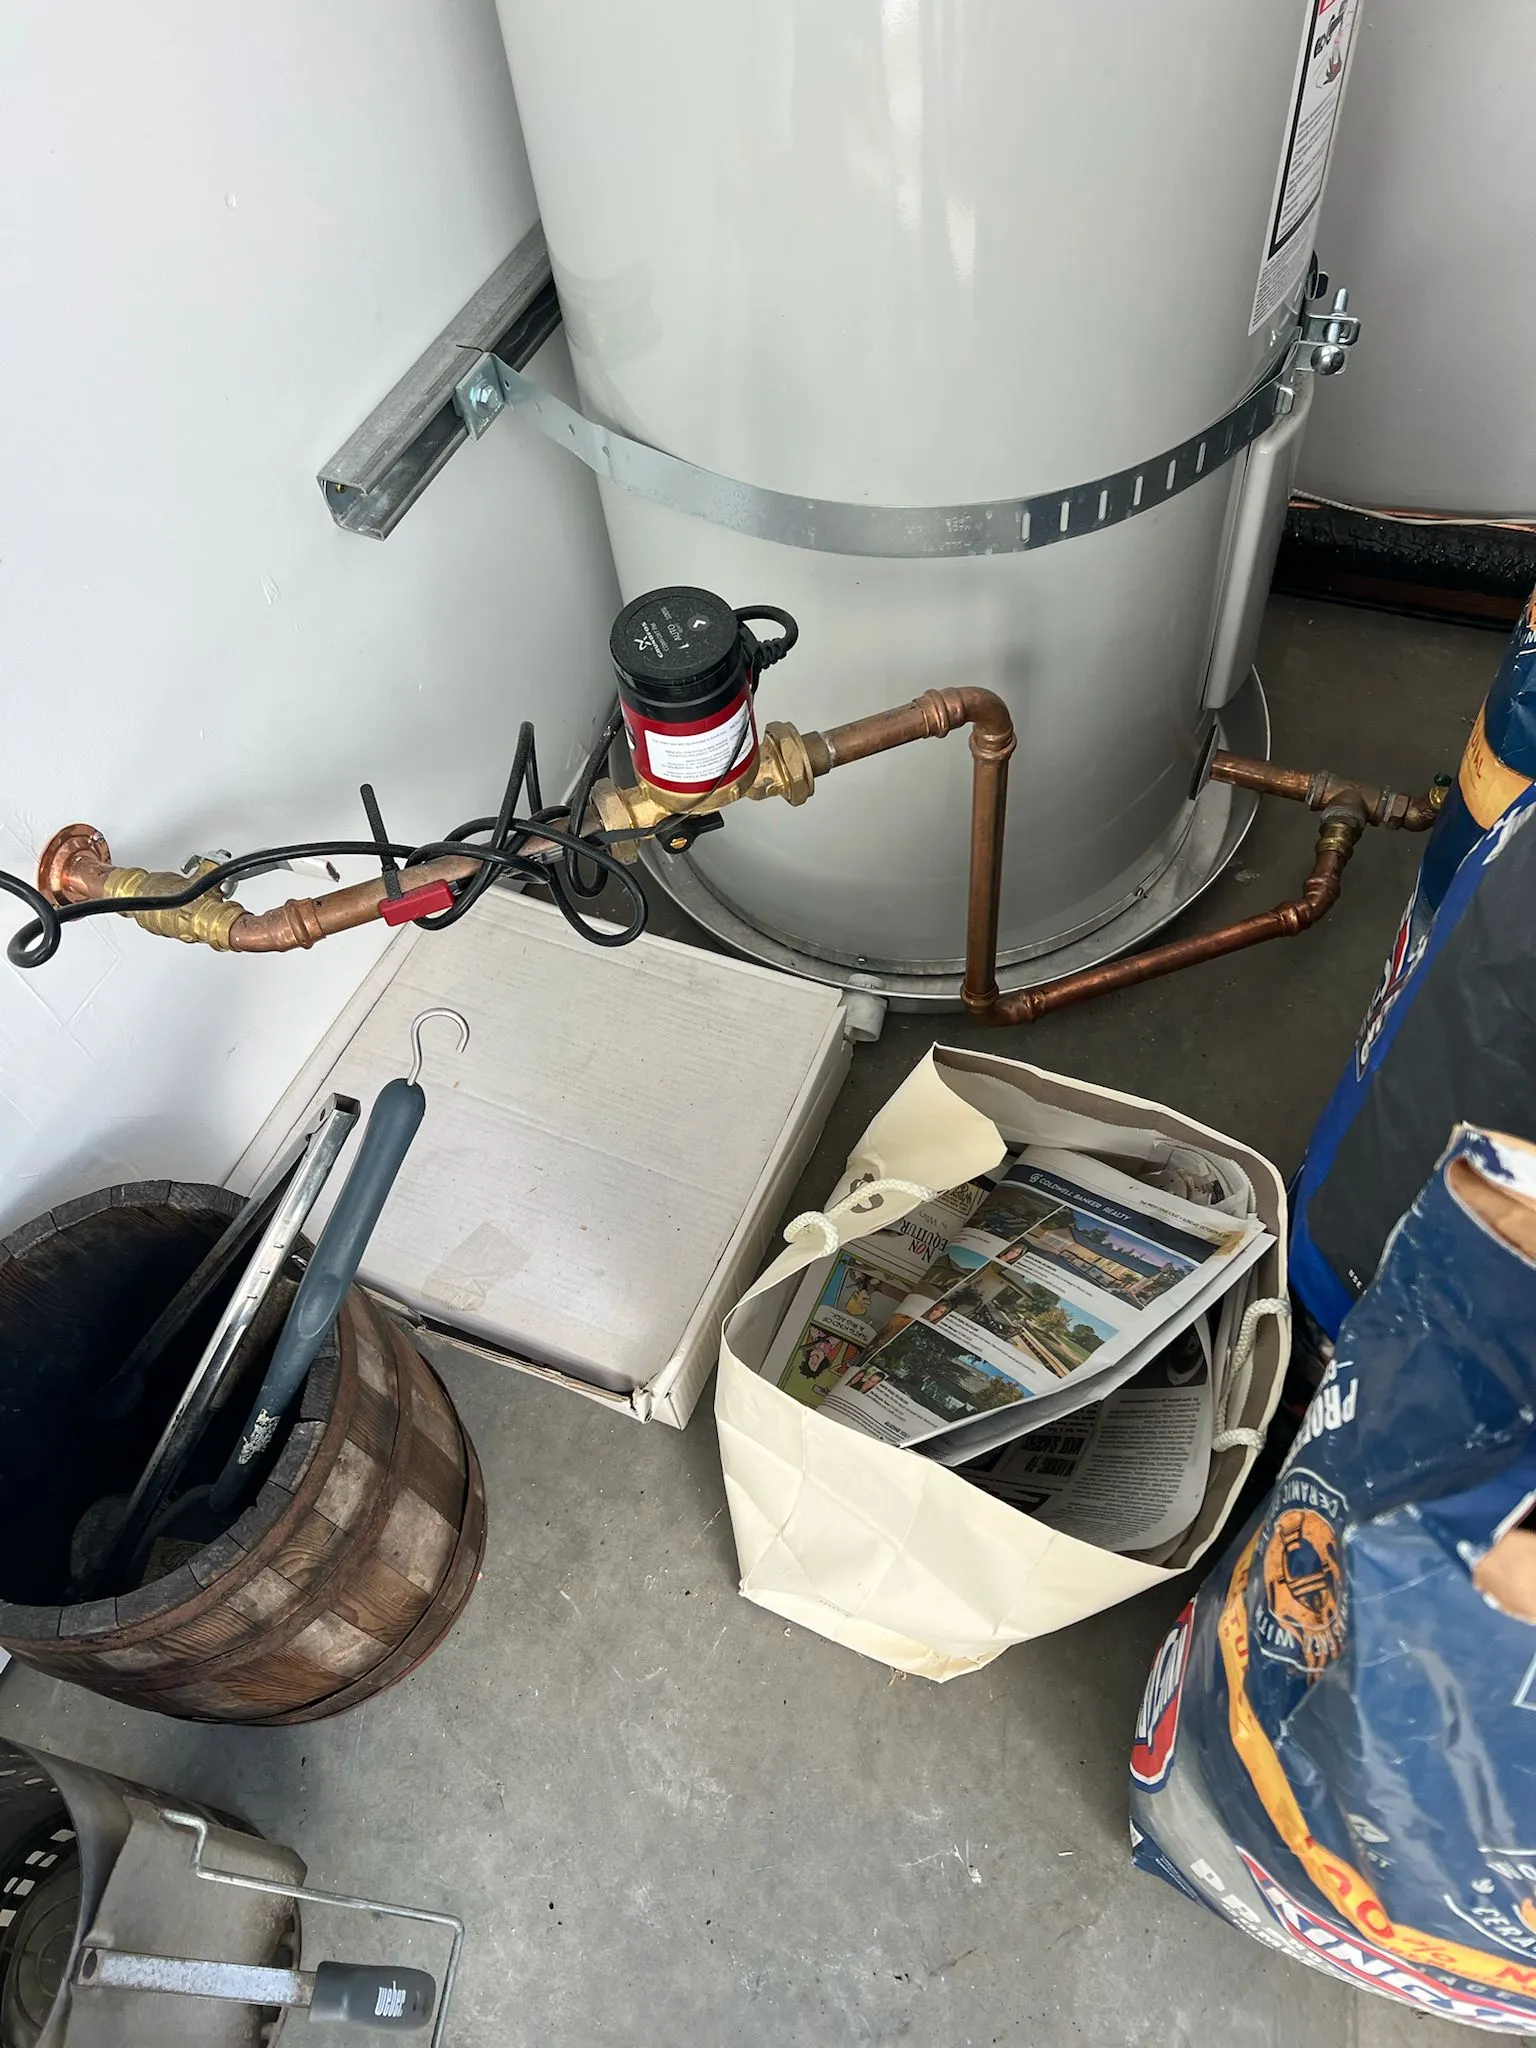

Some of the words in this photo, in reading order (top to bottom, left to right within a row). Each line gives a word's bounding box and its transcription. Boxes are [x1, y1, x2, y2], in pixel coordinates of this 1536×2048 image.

[640, 621, 664, 658] GRUNDFOS
[667, 623, 682, 641] AUTO
[1039, 1176, 1073, 1197] COLDWELL
[1072, 1190, 1102, 1209] BANKER
[1102, 1205, 1132, 1222] REALTY
[908, 1239, 935, 1263] NON
[374, 1980, 408, 2018] weber
